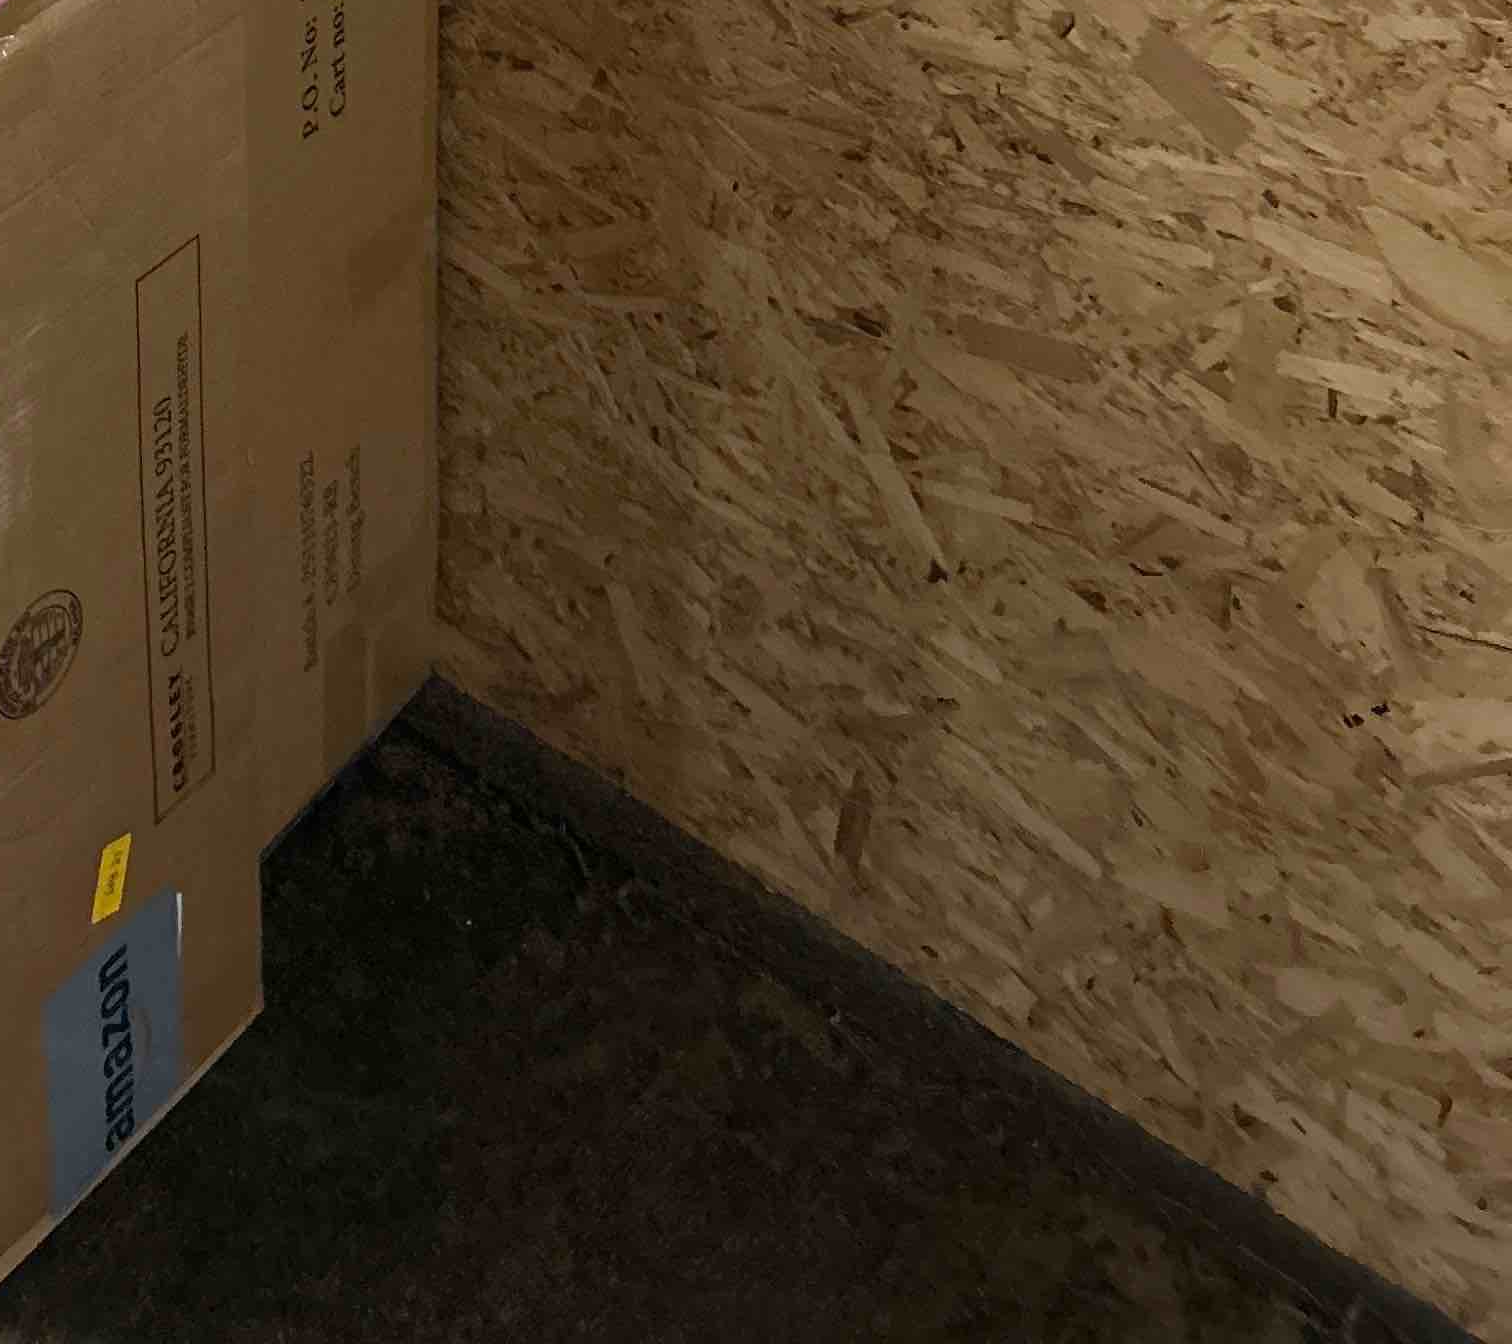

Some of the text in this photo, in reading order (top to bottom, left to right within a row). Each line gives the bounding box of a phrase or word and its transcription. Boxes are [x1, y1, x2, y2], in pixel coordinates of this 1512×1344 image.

[301, 16, 319, 65] No:
[331, 1, 345, 53] no:
[328, 58, 346, 117] Cart
[151, 392, 180, 665] CALIFORNIA 93120
[167, 667, 185, 798] CROSLEY
[98, 944, 137, 1152] amazon
